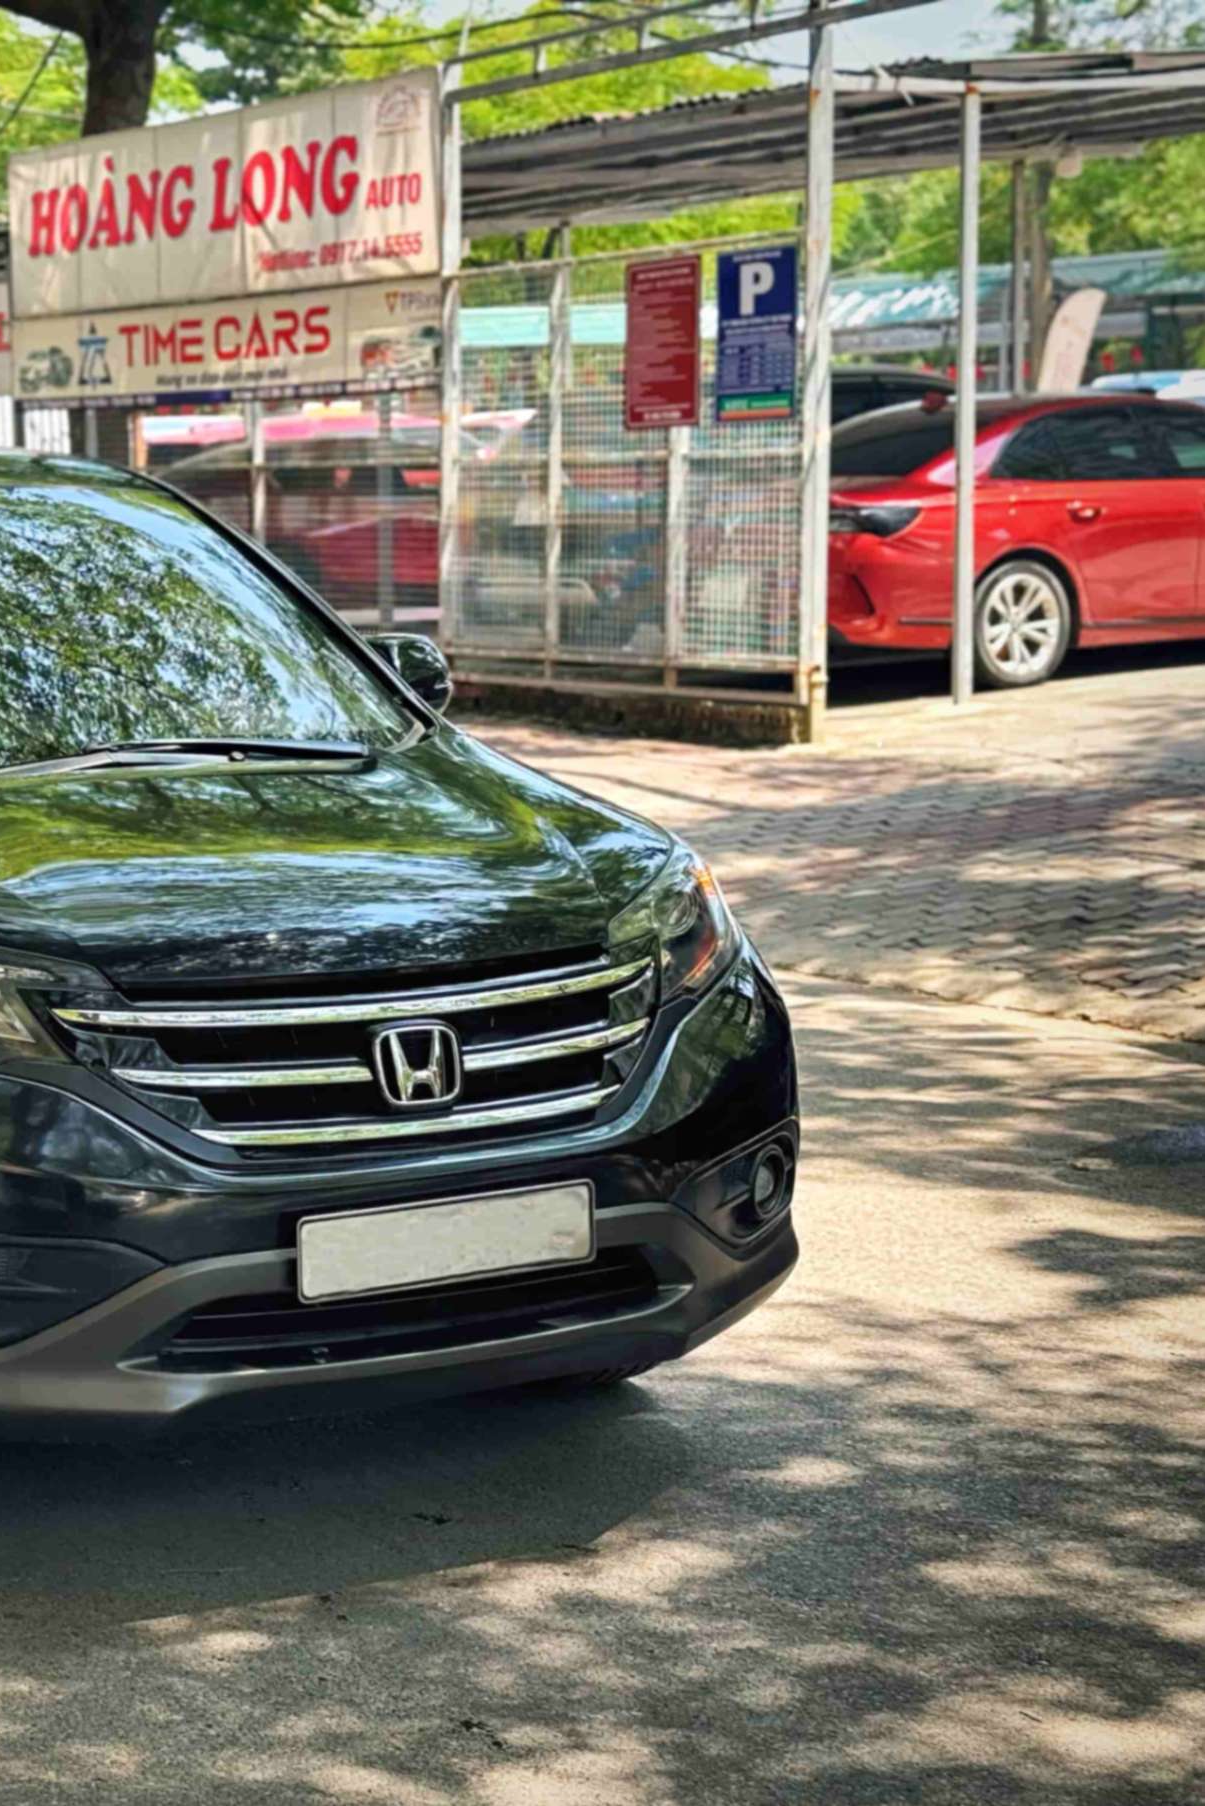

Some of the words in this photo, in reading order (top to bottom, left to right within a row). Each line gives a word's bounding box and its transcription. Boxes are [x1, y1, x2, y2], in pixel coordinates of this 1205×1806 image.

[28, 156, 194, 258] HOÀNG
[209, 135, 360, 233] LONG
[365, 173, 422, 210] AUTO
[739, 261, 775, 317] P
[118, 319, 205, 368] TIME
[214, 305, 331, 361] CARS
